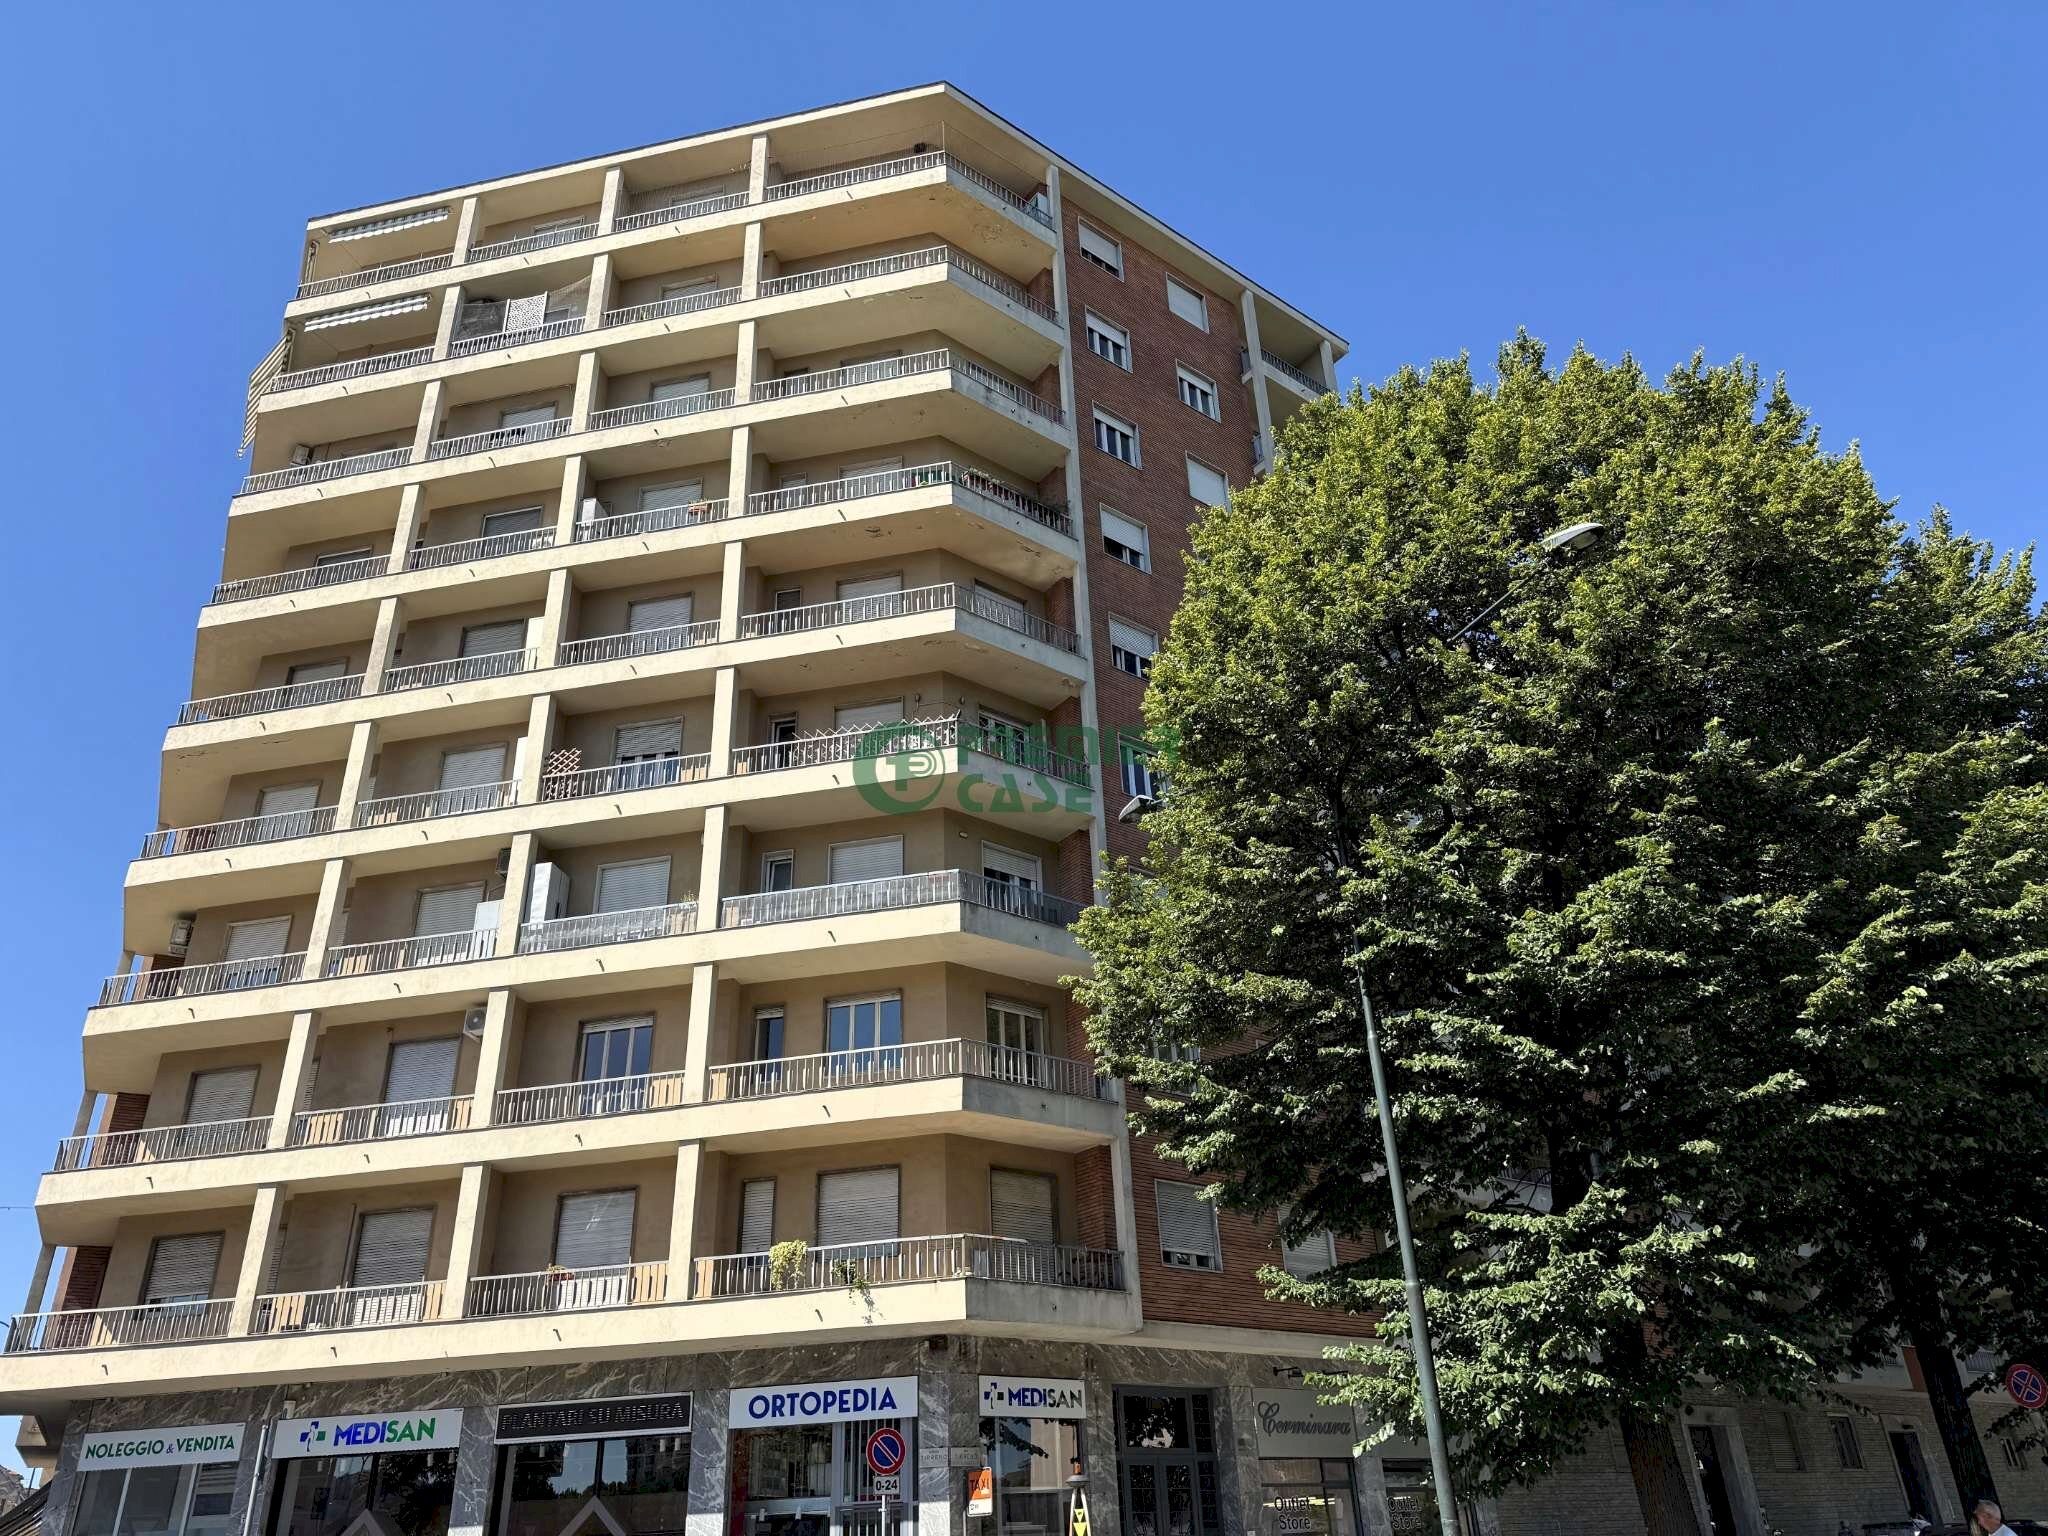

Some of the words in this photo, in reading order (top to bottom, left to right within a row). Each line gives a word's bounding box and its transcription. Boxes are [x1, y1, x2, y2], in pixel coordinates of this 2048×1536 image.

[748, 1386, 898, 1419] ORTOPEDIA
[1008, 1386, 1082, 1408] MEDISAN
[500, 1409, 584, 1430] PLANTARI
[588, 1407, 610, 1425] SU
[615, 1402, 685, 1423] MISURA
[333, 1418, 436, 1447] MEDISAN
[85, 1440, 164, 1459] NOLEGGIO
[166, 1443, 174, 1454] &
[176, 1435, 235, 1453] VENDITA
[875, 1479, 898, 1491] 0-24
[970, 1478, 990, 1491] TAXI
[1274, 1496, 1312, 1512] Outlet
[1279, 1514, 1311, 1530] Store
